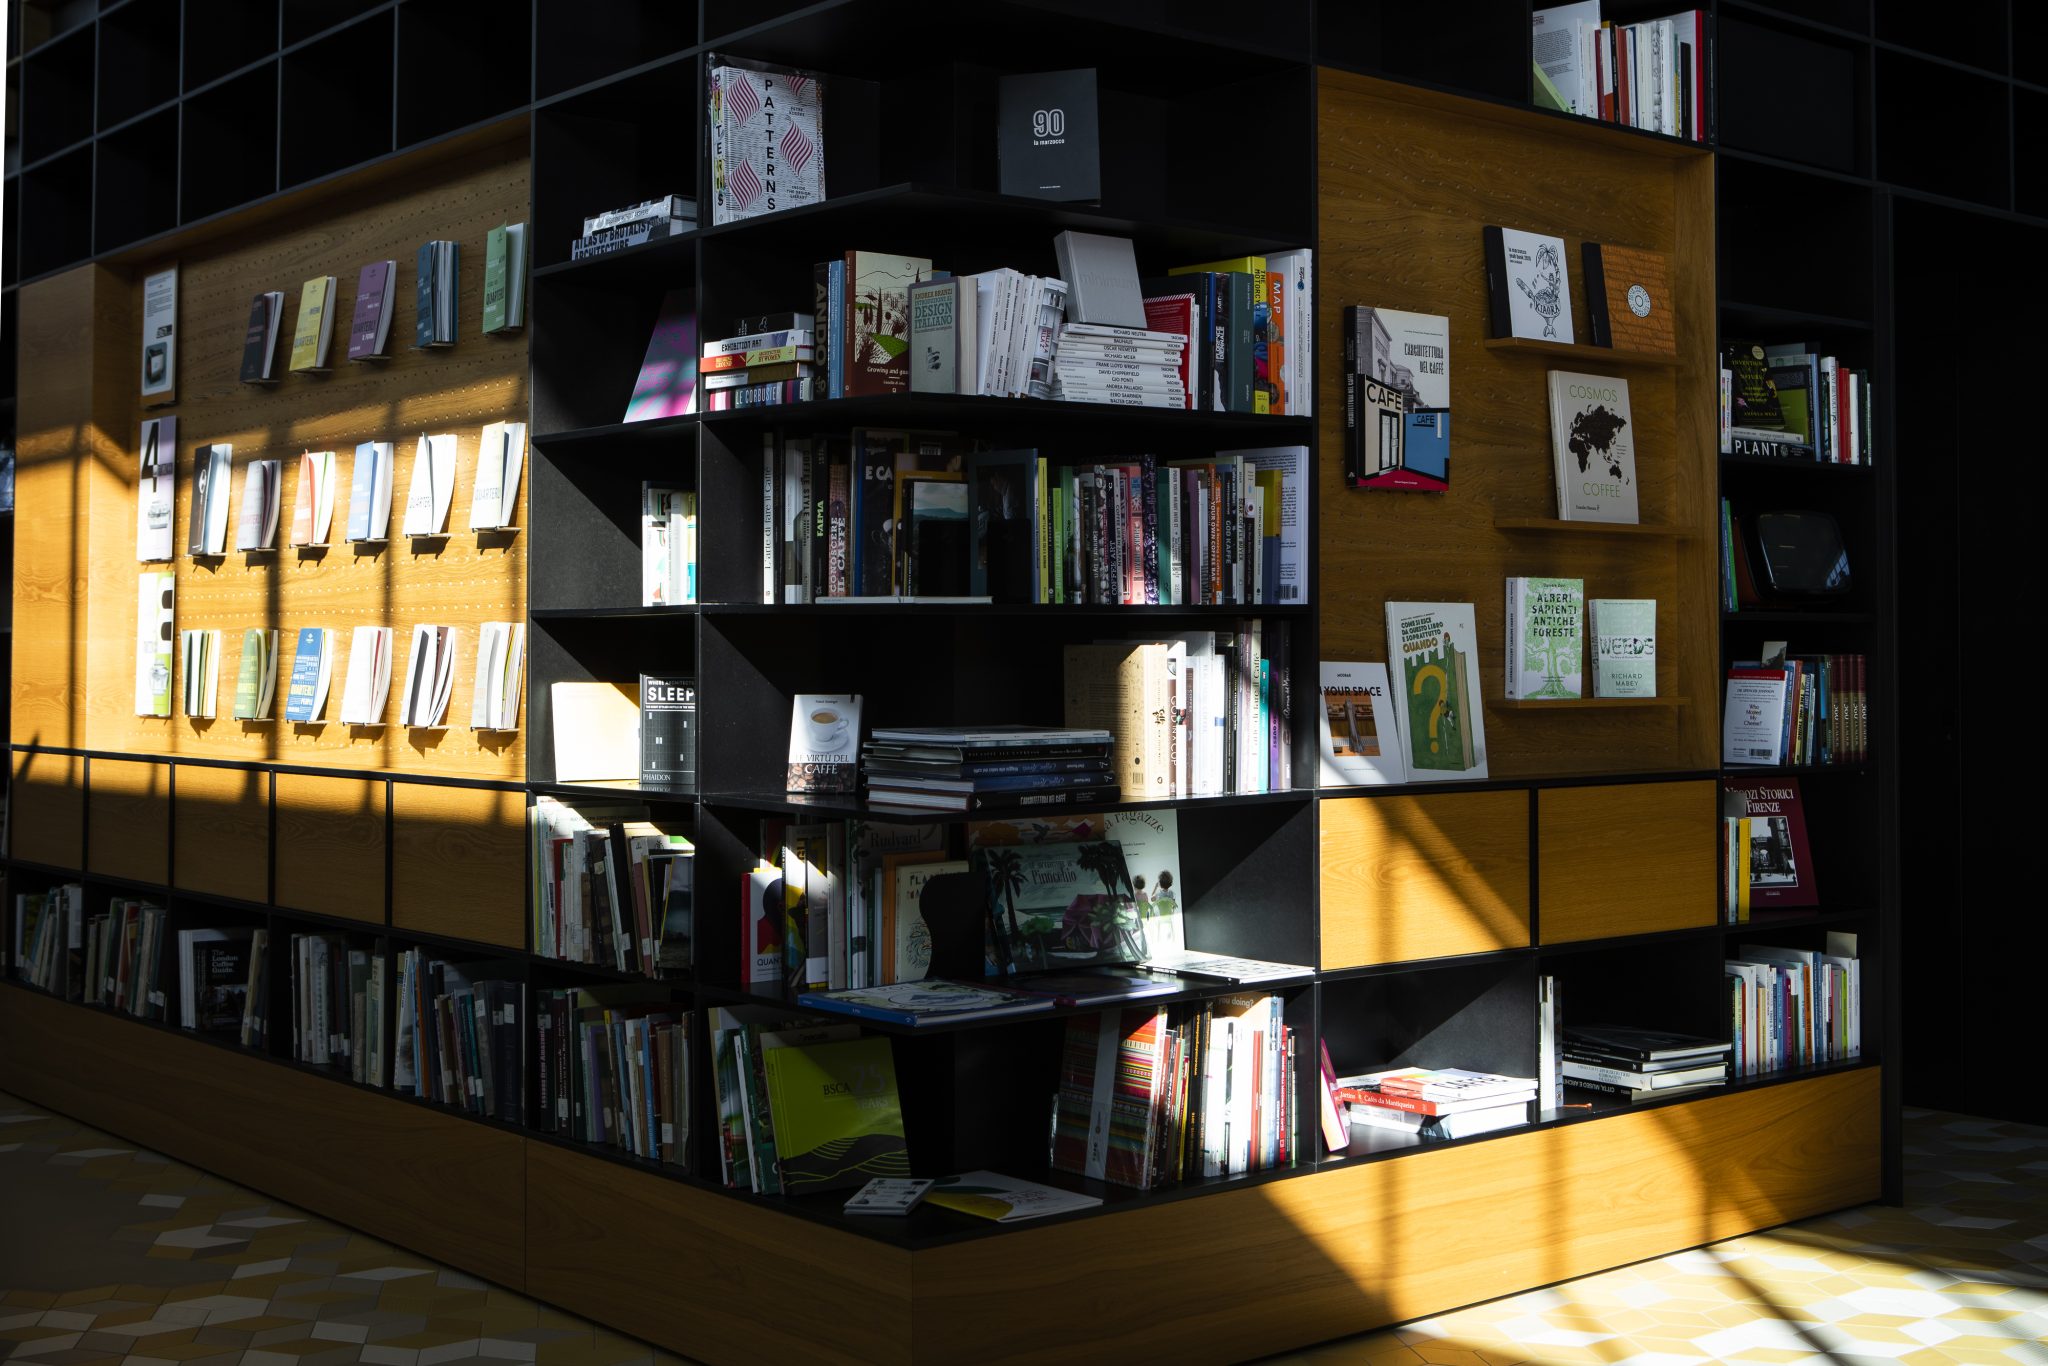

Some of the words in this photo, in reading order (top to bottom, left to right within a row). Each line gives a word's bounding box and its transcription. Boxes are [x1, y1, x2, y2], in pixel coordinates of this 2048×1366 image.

[1033, 109, 1064, 137] 90
[764, 79, 776, 210] PATTERNS
[574, 234, 598, 251] ATLAS
[599, 230, 609, 244] OF
[610, 222, 651, 241] BRUTALIST
[574, 238, 630, 260] ARCHITECTURE
[914, 302, 952, 320] DESIGN
[815, 283, 827, 367] ANDO
[914, 314, 952, 330] ITALIANO
[722, 340, 751, 352] EXHIBITION
[752, 339, 762, 349] ART
[1404, 342, 1444, 359] L'ARCHITETTURA
[866, 366, 888, 376] Growing
[1420, 360, 1428, 373] DEL
[736, 390, 744, 404] LE
[1366, 383, 1402, 412] CAFE
[1569, 384, 1618, 402] COSMOS
[1416, 414, 1435, 424] CAFE
[141, 421, 159, 492] 4
[1734, 440, 1778, 457] PLANT
[802, 450, 811, 486] COFFEE
[1582, 482, 1620, 498] COFFEE
[802, 488, 811, 516] STYLE
[816, 500, 825, 537] FAEMA
[830, 517, 838, 593] CONOSCERE
[838, 576, 846, 593] IL
[1532, 605, 1577, 614] SAPIENTI
[1400, 620, 1414, 628] COME
[1420, 616, 1432, 625] ESCE
[1409, 624, 1428, 634] QUESTO
[1428, 621, 1444, 631] LIBRO
[1533, 616, 1575, 626] ANTICHE
[1406, 629, 1442, 642] SOPRATTUTTO
[1533, 628, 1574, 637] FORESTE
[1402, 638, 1438, 653] QUANDO
[1600, 636, 1654, 655] WEEDS
[648, 686, 695, 702] SLEEP
[1324, 686, 1350, 696] YOUR
[1352, 686, 1382, 696] SPACE
[642, 773, 670, 781] PHAIDON
[1760, 786, 1794, 800] STORICI
[1746, 800, 1781, 814] FIRENZE
[1114, 811, 1164, 833] ragazze
[870, 829, 921, 849] Rudyard
[1032, 867, 1077, 885] Pinocchio
[1218, 996, 1230, 1004] you
[1231, 996, 1254, 1008] doing?
[824, 1082, 850, 1096] BSCA
[1583, 1082, 1600, 1090] MUSEO
[1364, 1095, 1378, 1103] Cafés
[1386, 1098, 1415, 1110] Mantiqueira
